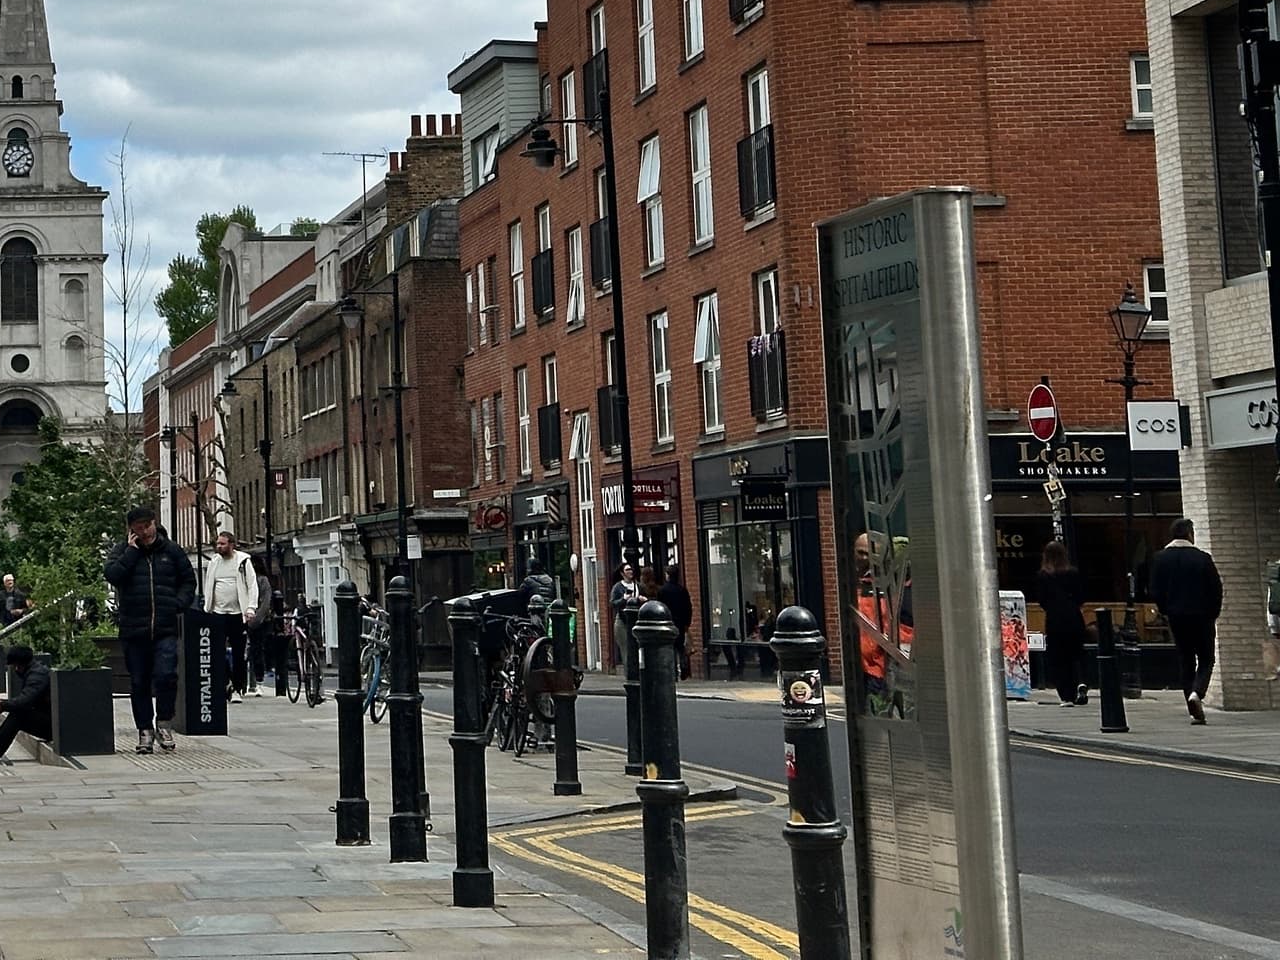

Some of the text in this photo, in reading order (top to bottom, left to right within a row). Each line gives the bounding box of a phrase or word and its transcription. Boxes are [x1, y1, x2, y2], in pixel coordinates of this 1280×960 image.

[843, 212, 907, 258] HISTORIC
[1136, 419, 1176, 433] COS
[745, 494, 784, 505] Loake
